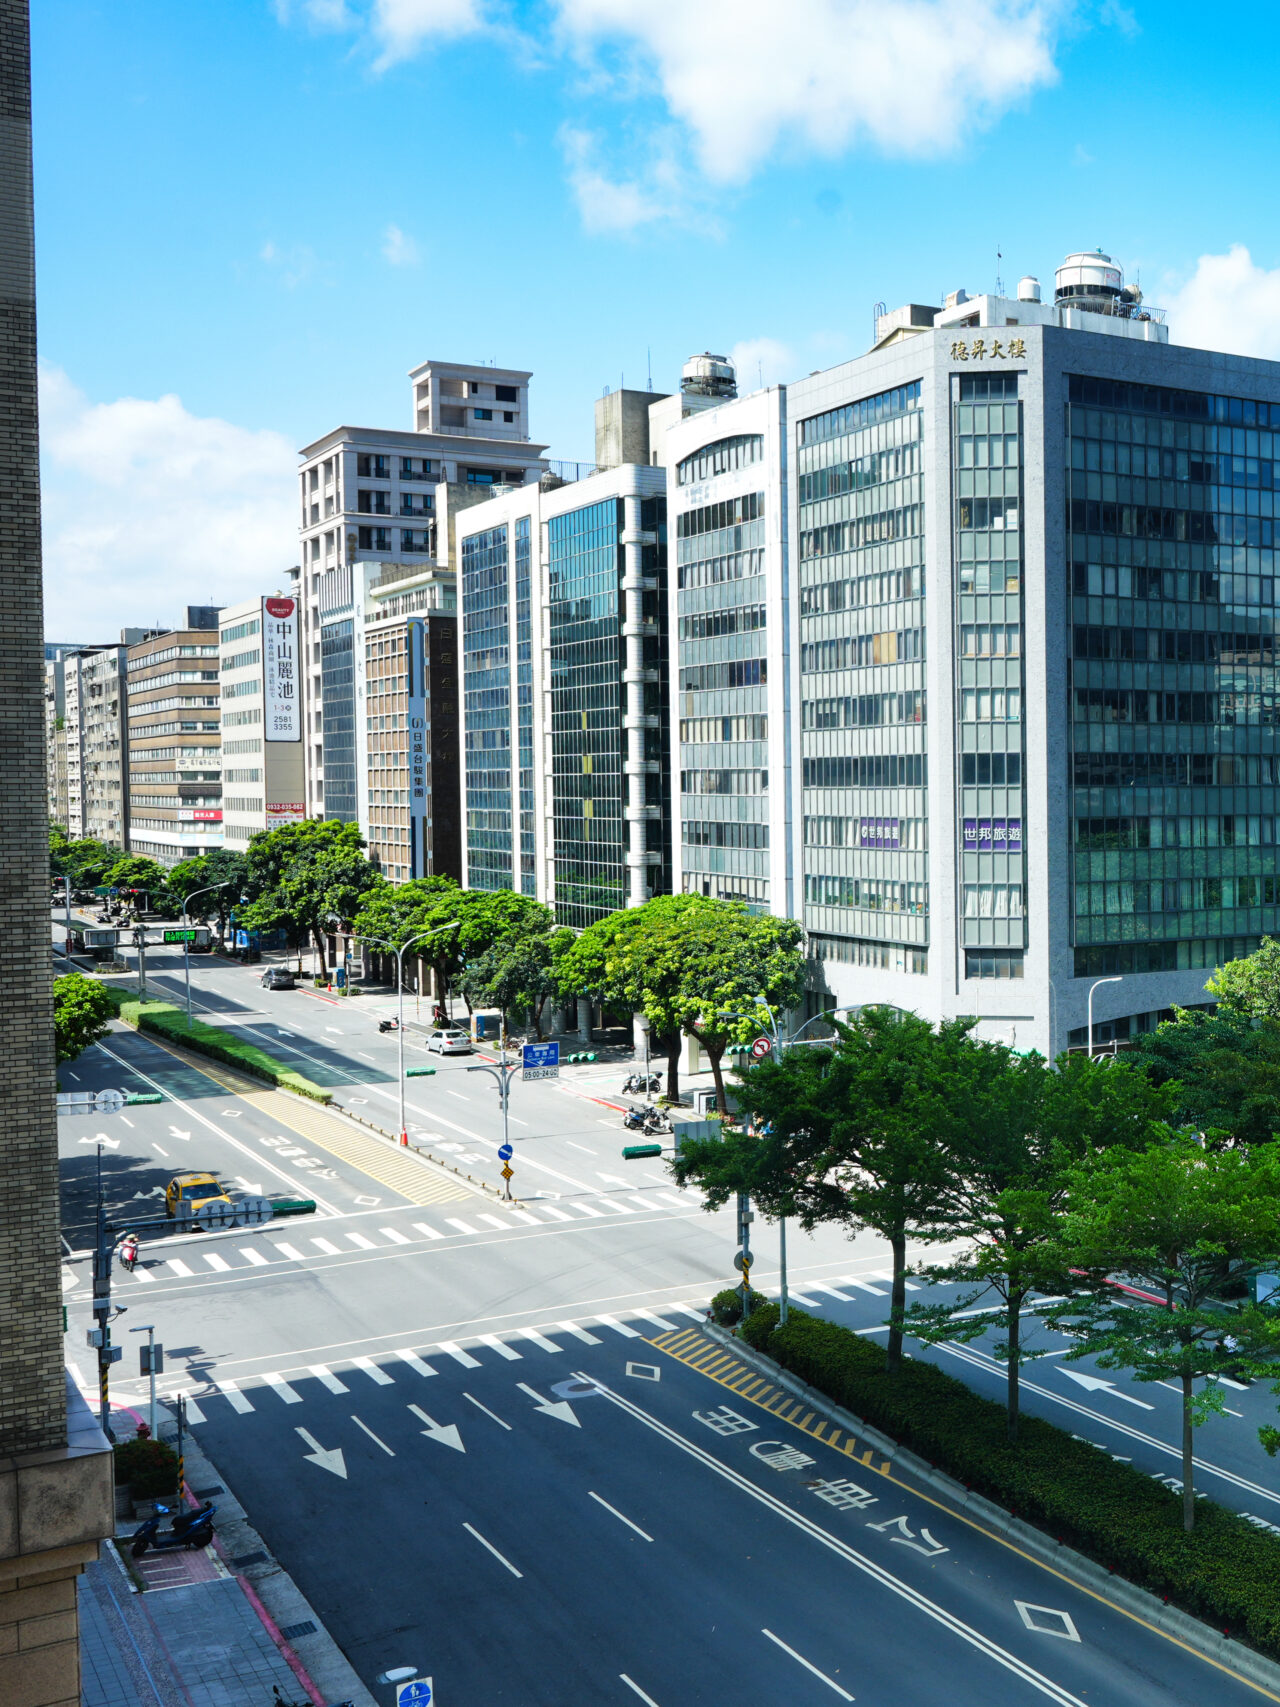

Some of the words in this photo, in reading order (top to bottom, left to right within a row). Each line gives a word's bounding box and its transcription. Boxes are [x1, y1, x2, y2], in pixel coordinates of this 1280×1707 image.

[950, 338, 1027, 361] 德昇大樓
[276, 621, 294, 699] 中山麗池
[273, 715, 292, 723] 2581
[273, 723, 293, 731] 3355
[413, 732, 424, 798] 日盛台駿集團
[963, 827, 1022, 841] 世邦旅遊
[691, 1405, 951, 1557] 公車專用
